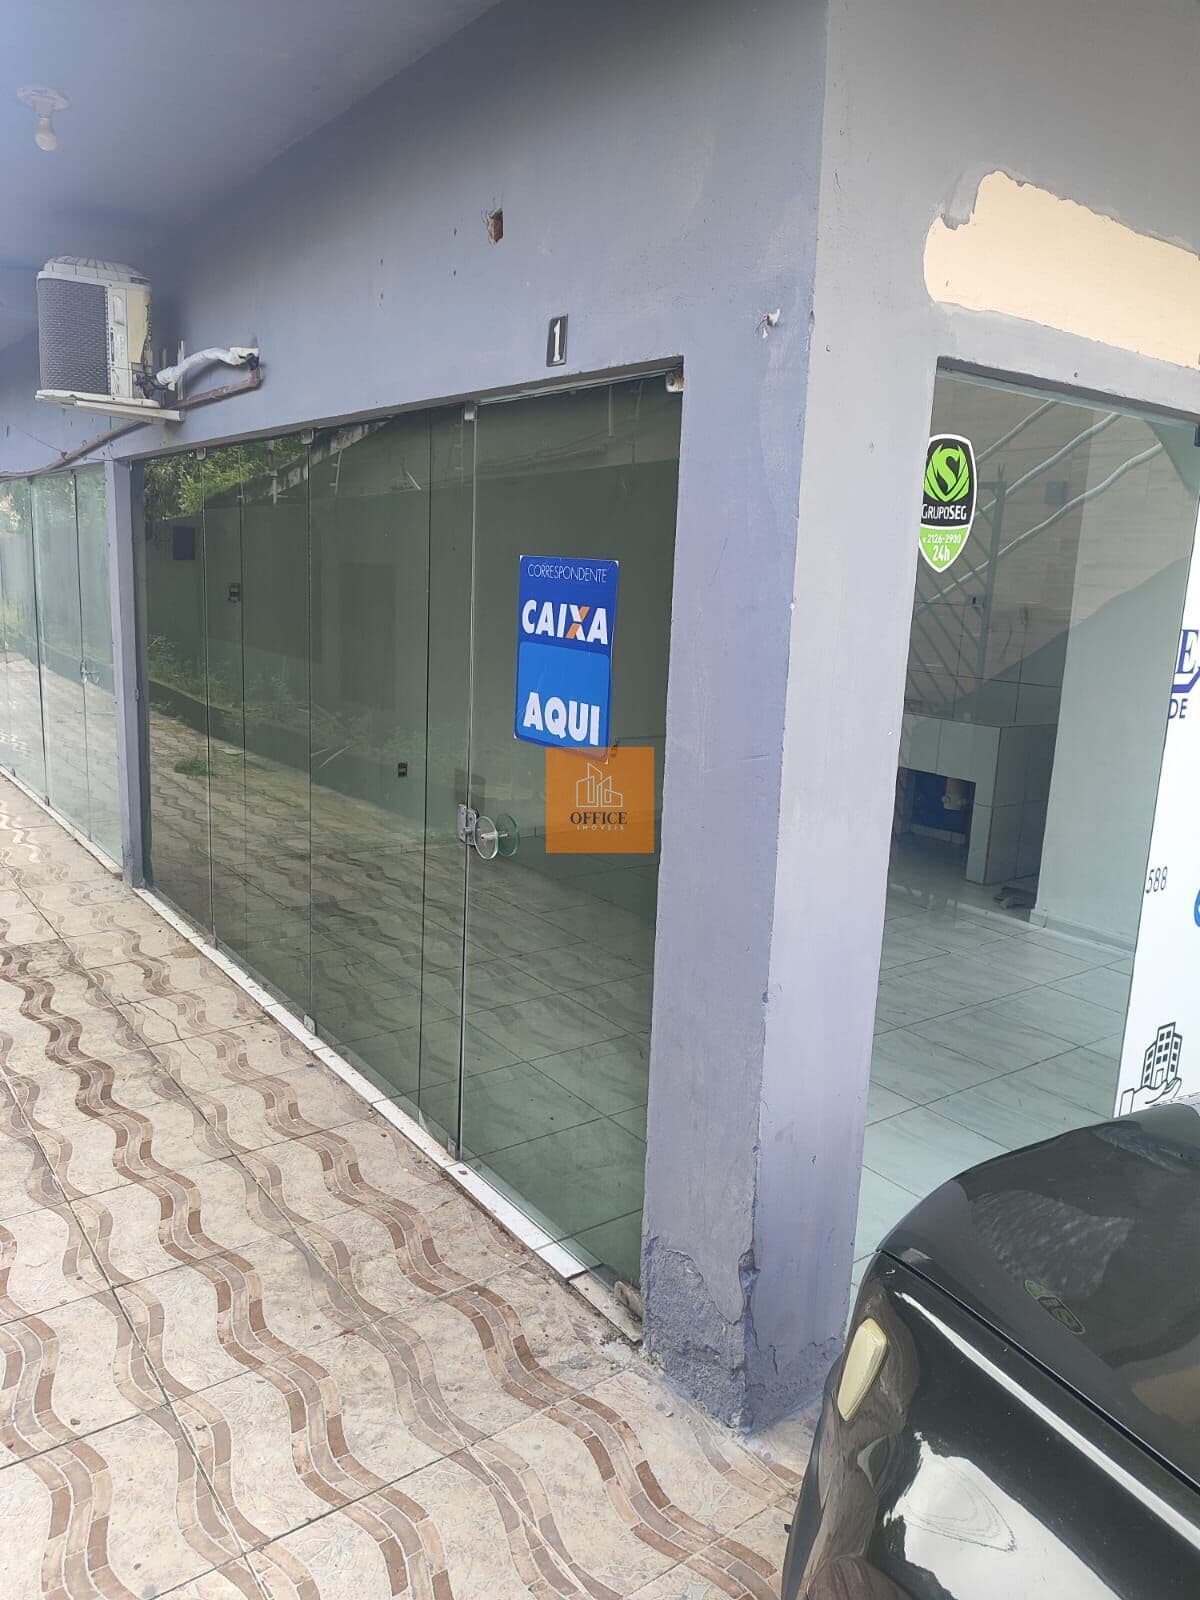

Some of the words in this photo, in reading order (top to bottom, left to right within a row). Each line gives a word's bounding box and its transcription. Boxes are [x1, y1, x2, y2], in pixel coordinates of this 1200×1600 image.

[553, 319, 561, 362] 1
[932, 544, 951, 561] 24h
[527, 563, 608, 584] CORRESPONDENTE
[522, 599, 608, 645] CAIXA
[523, 692, 600, 746] AQUI
[1146, 866, 1168, 894] 588
